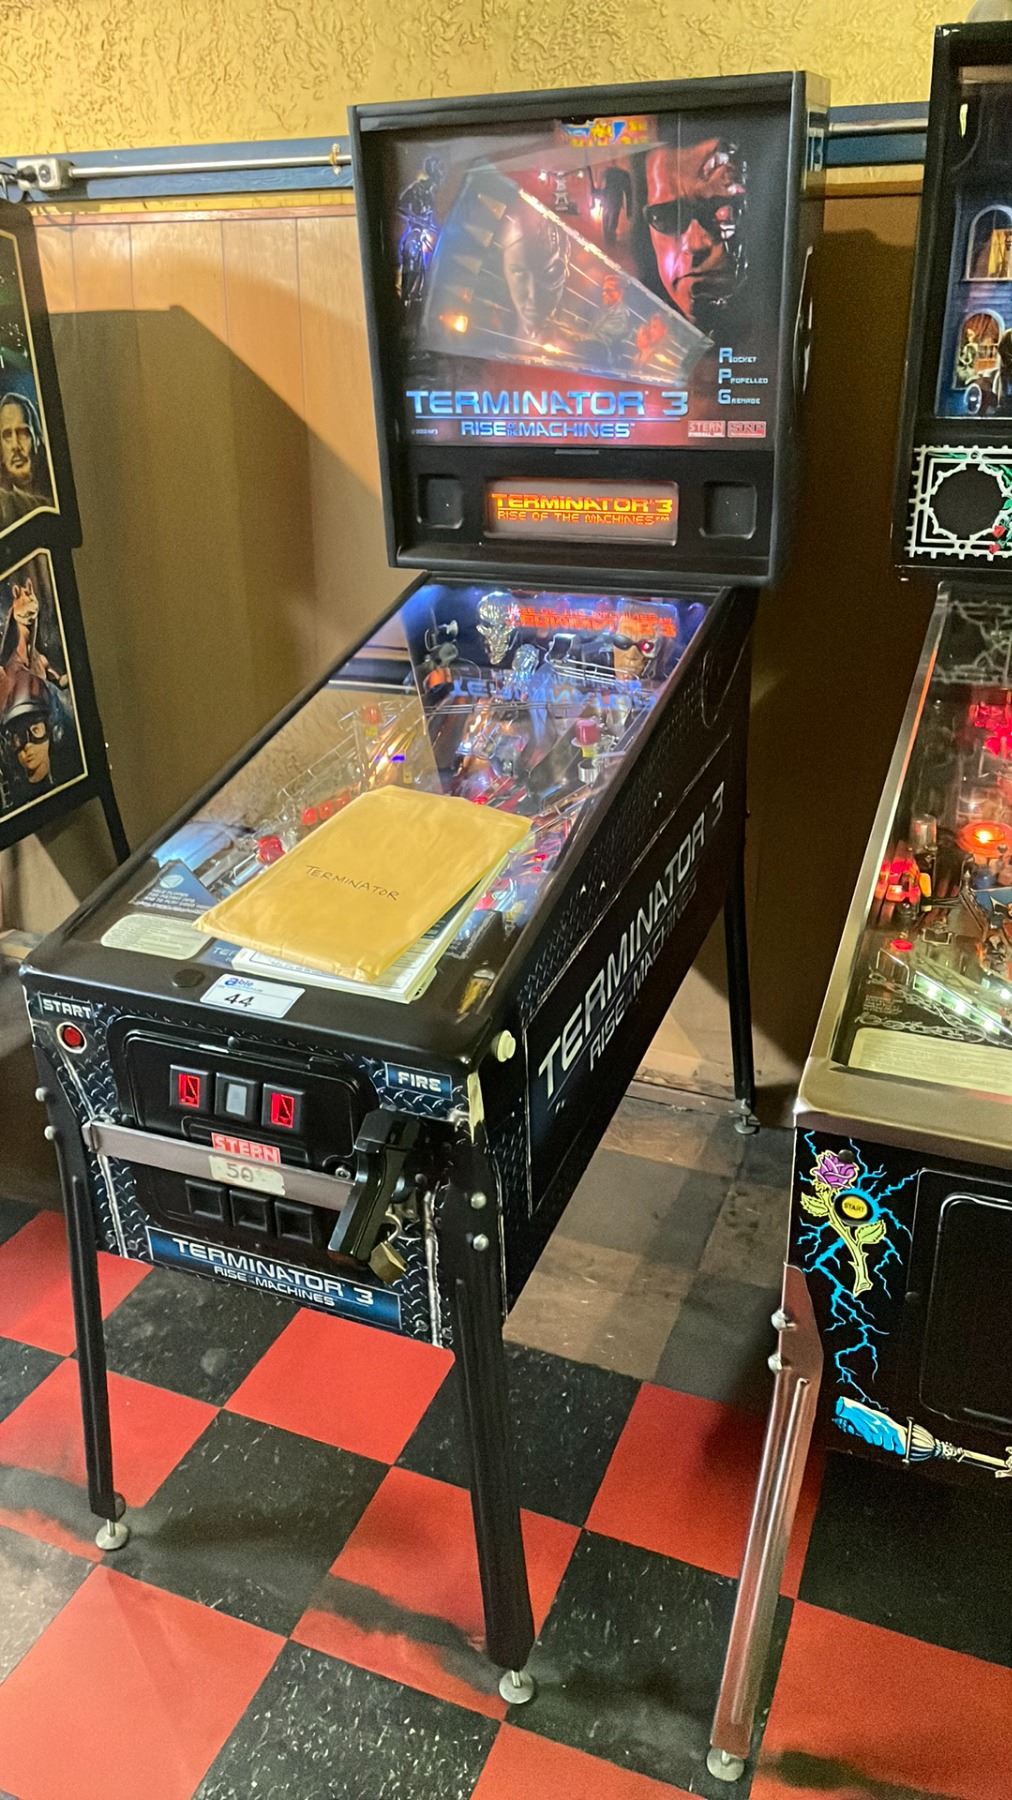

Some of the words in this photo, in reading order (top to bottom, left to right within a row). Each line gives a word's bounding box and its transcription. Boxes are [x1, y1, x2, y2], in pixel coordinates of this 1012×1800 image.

[405, 389, 646, 417] TERMINATOR
[660, 390, 689, 417] 3
[460, 420, 507, 437] RISE
[490, 493, 650, 513] TERMINATOR
[655, 499, 673, 514] 3
[496, 510, 527, 521] RISE
[531, 512, 549, 522] OF
[554, 512, 580, 523] THE
[305, 865, 400, 901] TERMINATOR
[538, 812, 705, 1100] TERMINATOR
[42, 998, 91, 1020] START
[224, 993, 251, 1008] 44
[590, 991, 625, 1072] RISE
[397, 1071, 442, 1093] FIRE
[213, 1135, 279, 1163] STERN
[226, 1161, 254, 1183] 50
[172, 1237, 345, 1297] TERMINATOR
[353, 1286, 375, 1306] 3
[213, 1265, 248, 1281] RISE
[254, 1276, 336, 1307] MACHINES
